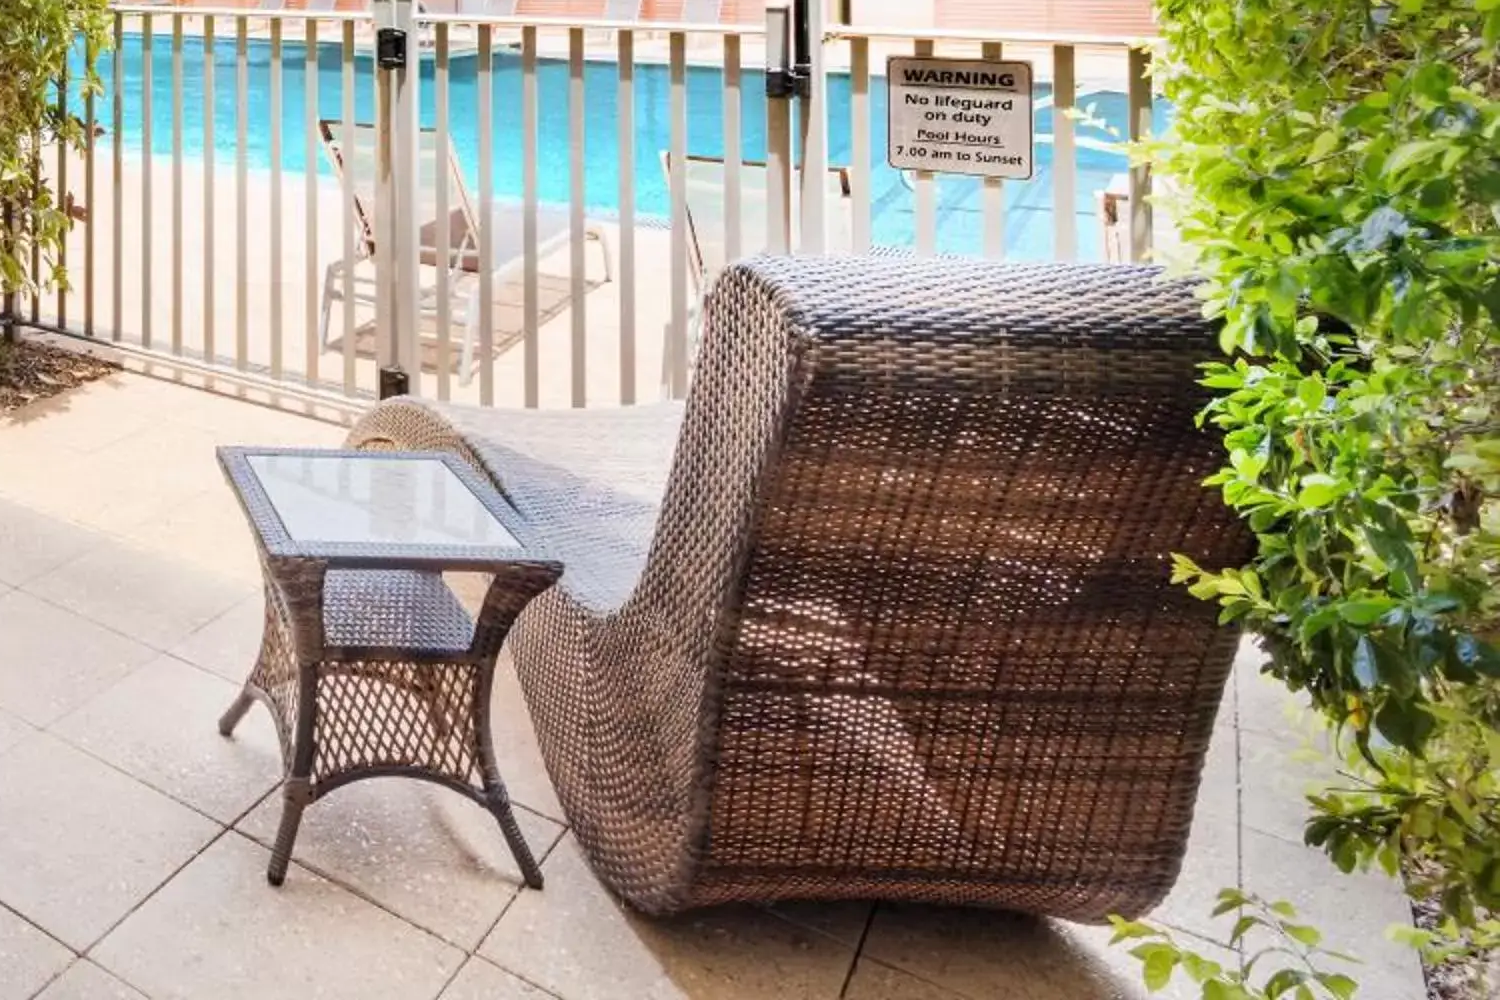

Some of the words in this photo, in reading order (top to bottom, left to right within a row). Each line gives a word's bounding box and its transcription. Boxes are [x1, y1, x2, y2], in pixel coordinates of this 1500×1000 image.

[903, 69, 1015, 87] WARNING
[905, 94, 929, 105] No
[935, 95, 1013, 111] lifeguard
[924, 111, 947, 121] on
[952, 111, 991, 127] duty
[917, 129, 950, 141] Pool
[955, 131, 1001, 145] Hours
[896, 145, 927, 158] 7.00
[931, 149, 952, 160] am
[957, 151, 971, 162] to
[975, 151, 1023, 166] Sunset
